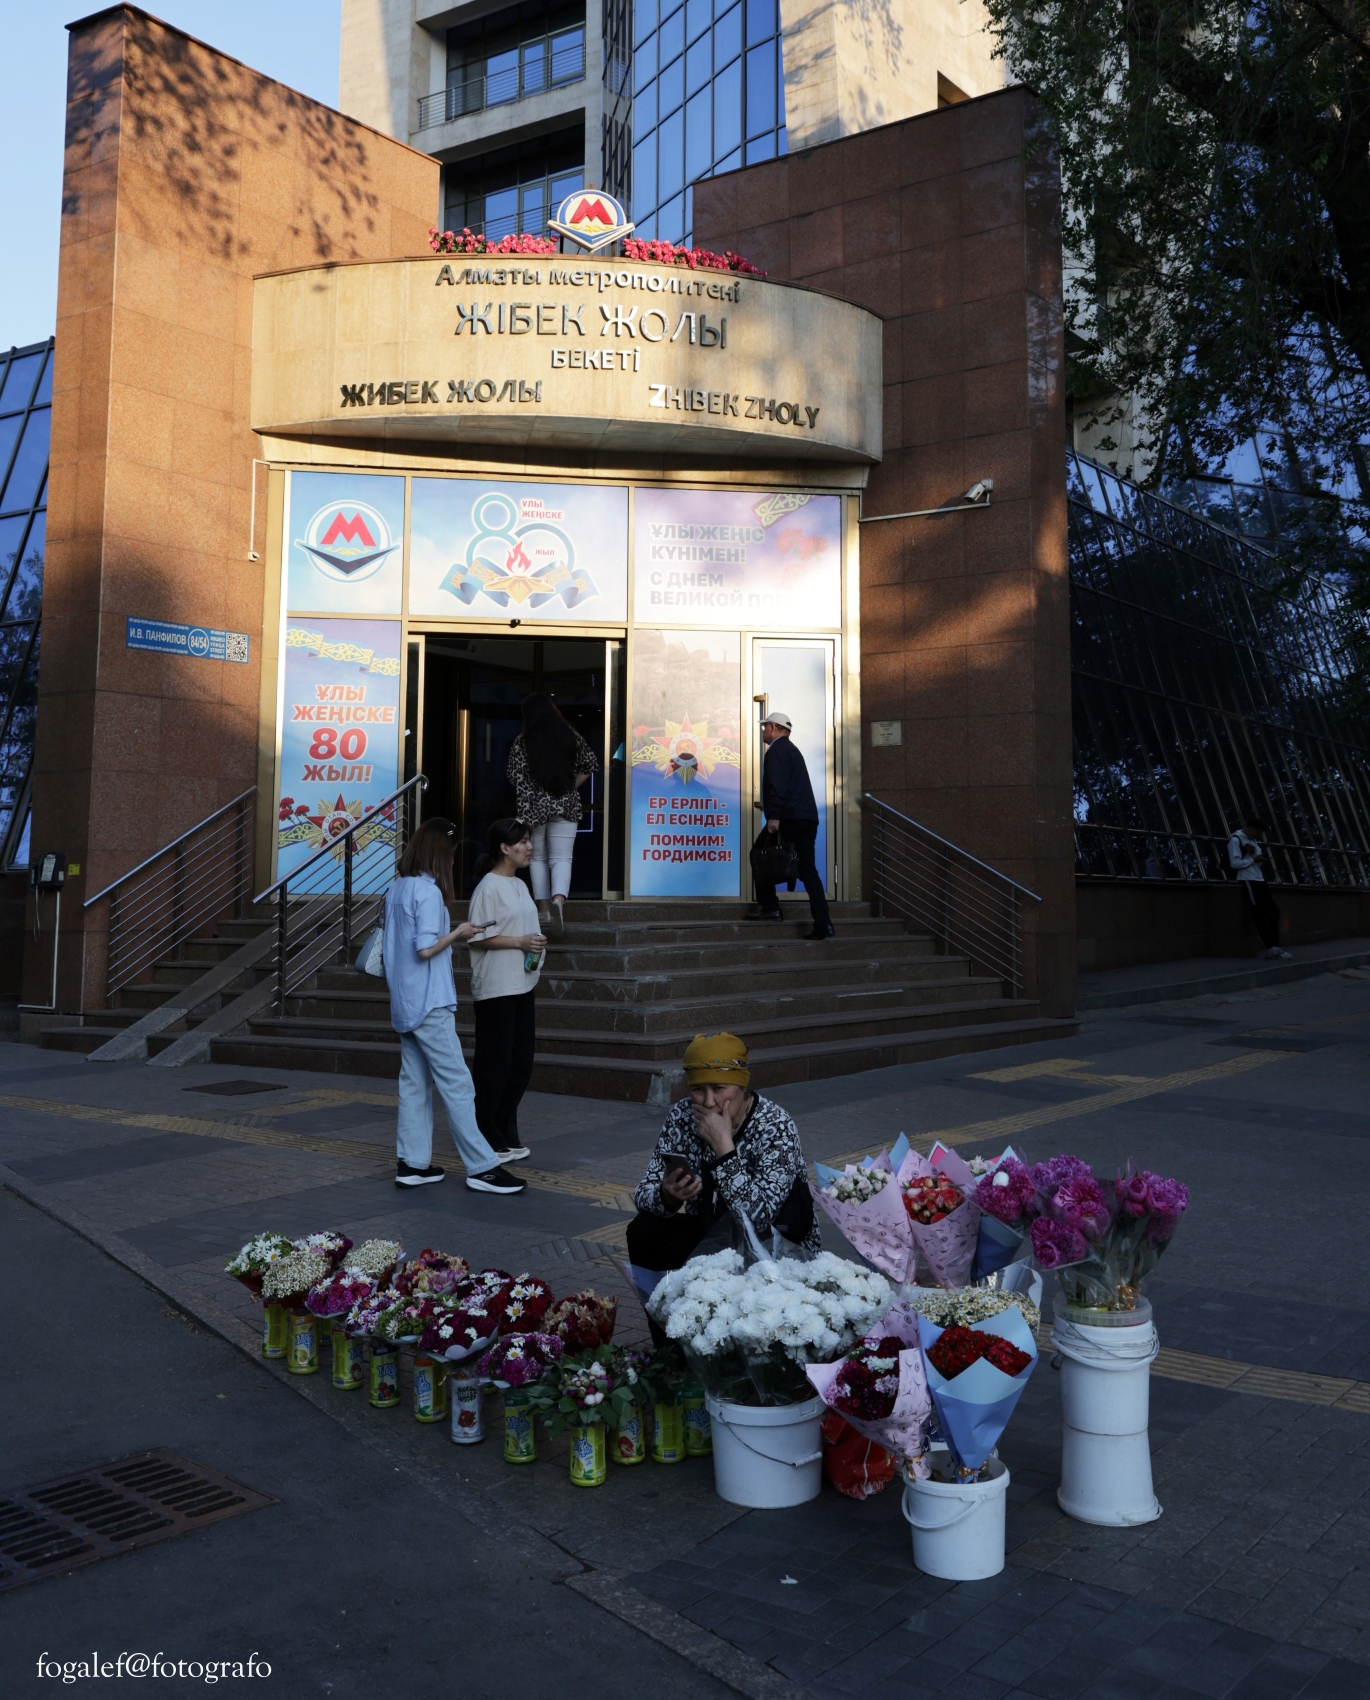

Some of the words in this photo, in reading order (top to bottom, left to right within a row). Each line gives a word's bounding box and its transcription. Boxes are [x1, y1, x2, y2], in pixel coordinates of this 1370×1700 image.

[435, 264, 542, 286] Алматы
[549, 268, 740, 303] метрополитені
[454, 302, 587, 335] ЖІБЕК
[599, 304, 727, 349] ЖОЛЫ
[340, 380, 440, 407] ЖИБЕК
[446, 378, 543, 403] ЖОЛЫ
[649, 383, 740, 417] ZHIBEK
[744, 395, 821, 429] ZHOLY
[521, 509, 563, 520] ЖЕҢІСКЕ
[650, 523, 695, 541] ҰЛЫ
[698, 525, 765, 546] ЖЕҢІС
[534, 548, 555, 556] ЖЫЛ
[651, 545, 746, 563] КҮНІМЕН!
[650, 570, 663, 586] С
[667, 571, 724, 588] ДНЕМ
[650, 589, 743, 607] ВЕЛИКОЙ
[130, 627, 144, 640] И.В.
[146, 629, 187, 646] ПАНФИЛОВ
[190, 635, 207, 649] 84/54
[316, 685, 365, 702] ҰЛЫ
[292, 705, 396, 724] ЖЕҢІСКЕ
[308, 727, 367, 760] 80
[302, 764, 372, 782] ЖЫЛ!
[649, 797, 668, 810] ЕР
[671, 797, 718, 810] ЕРЛІГІ
[325, 812, 342, 824] ОТАН
[646, 813, 666, 825] ЕЛ
[669, 813, 729, 828] ЕСІНДЕ!
[650, 834, 725, 847] ПОМНИМ!
[642, 849, 732, 863] ГОРДИМСЯ!
